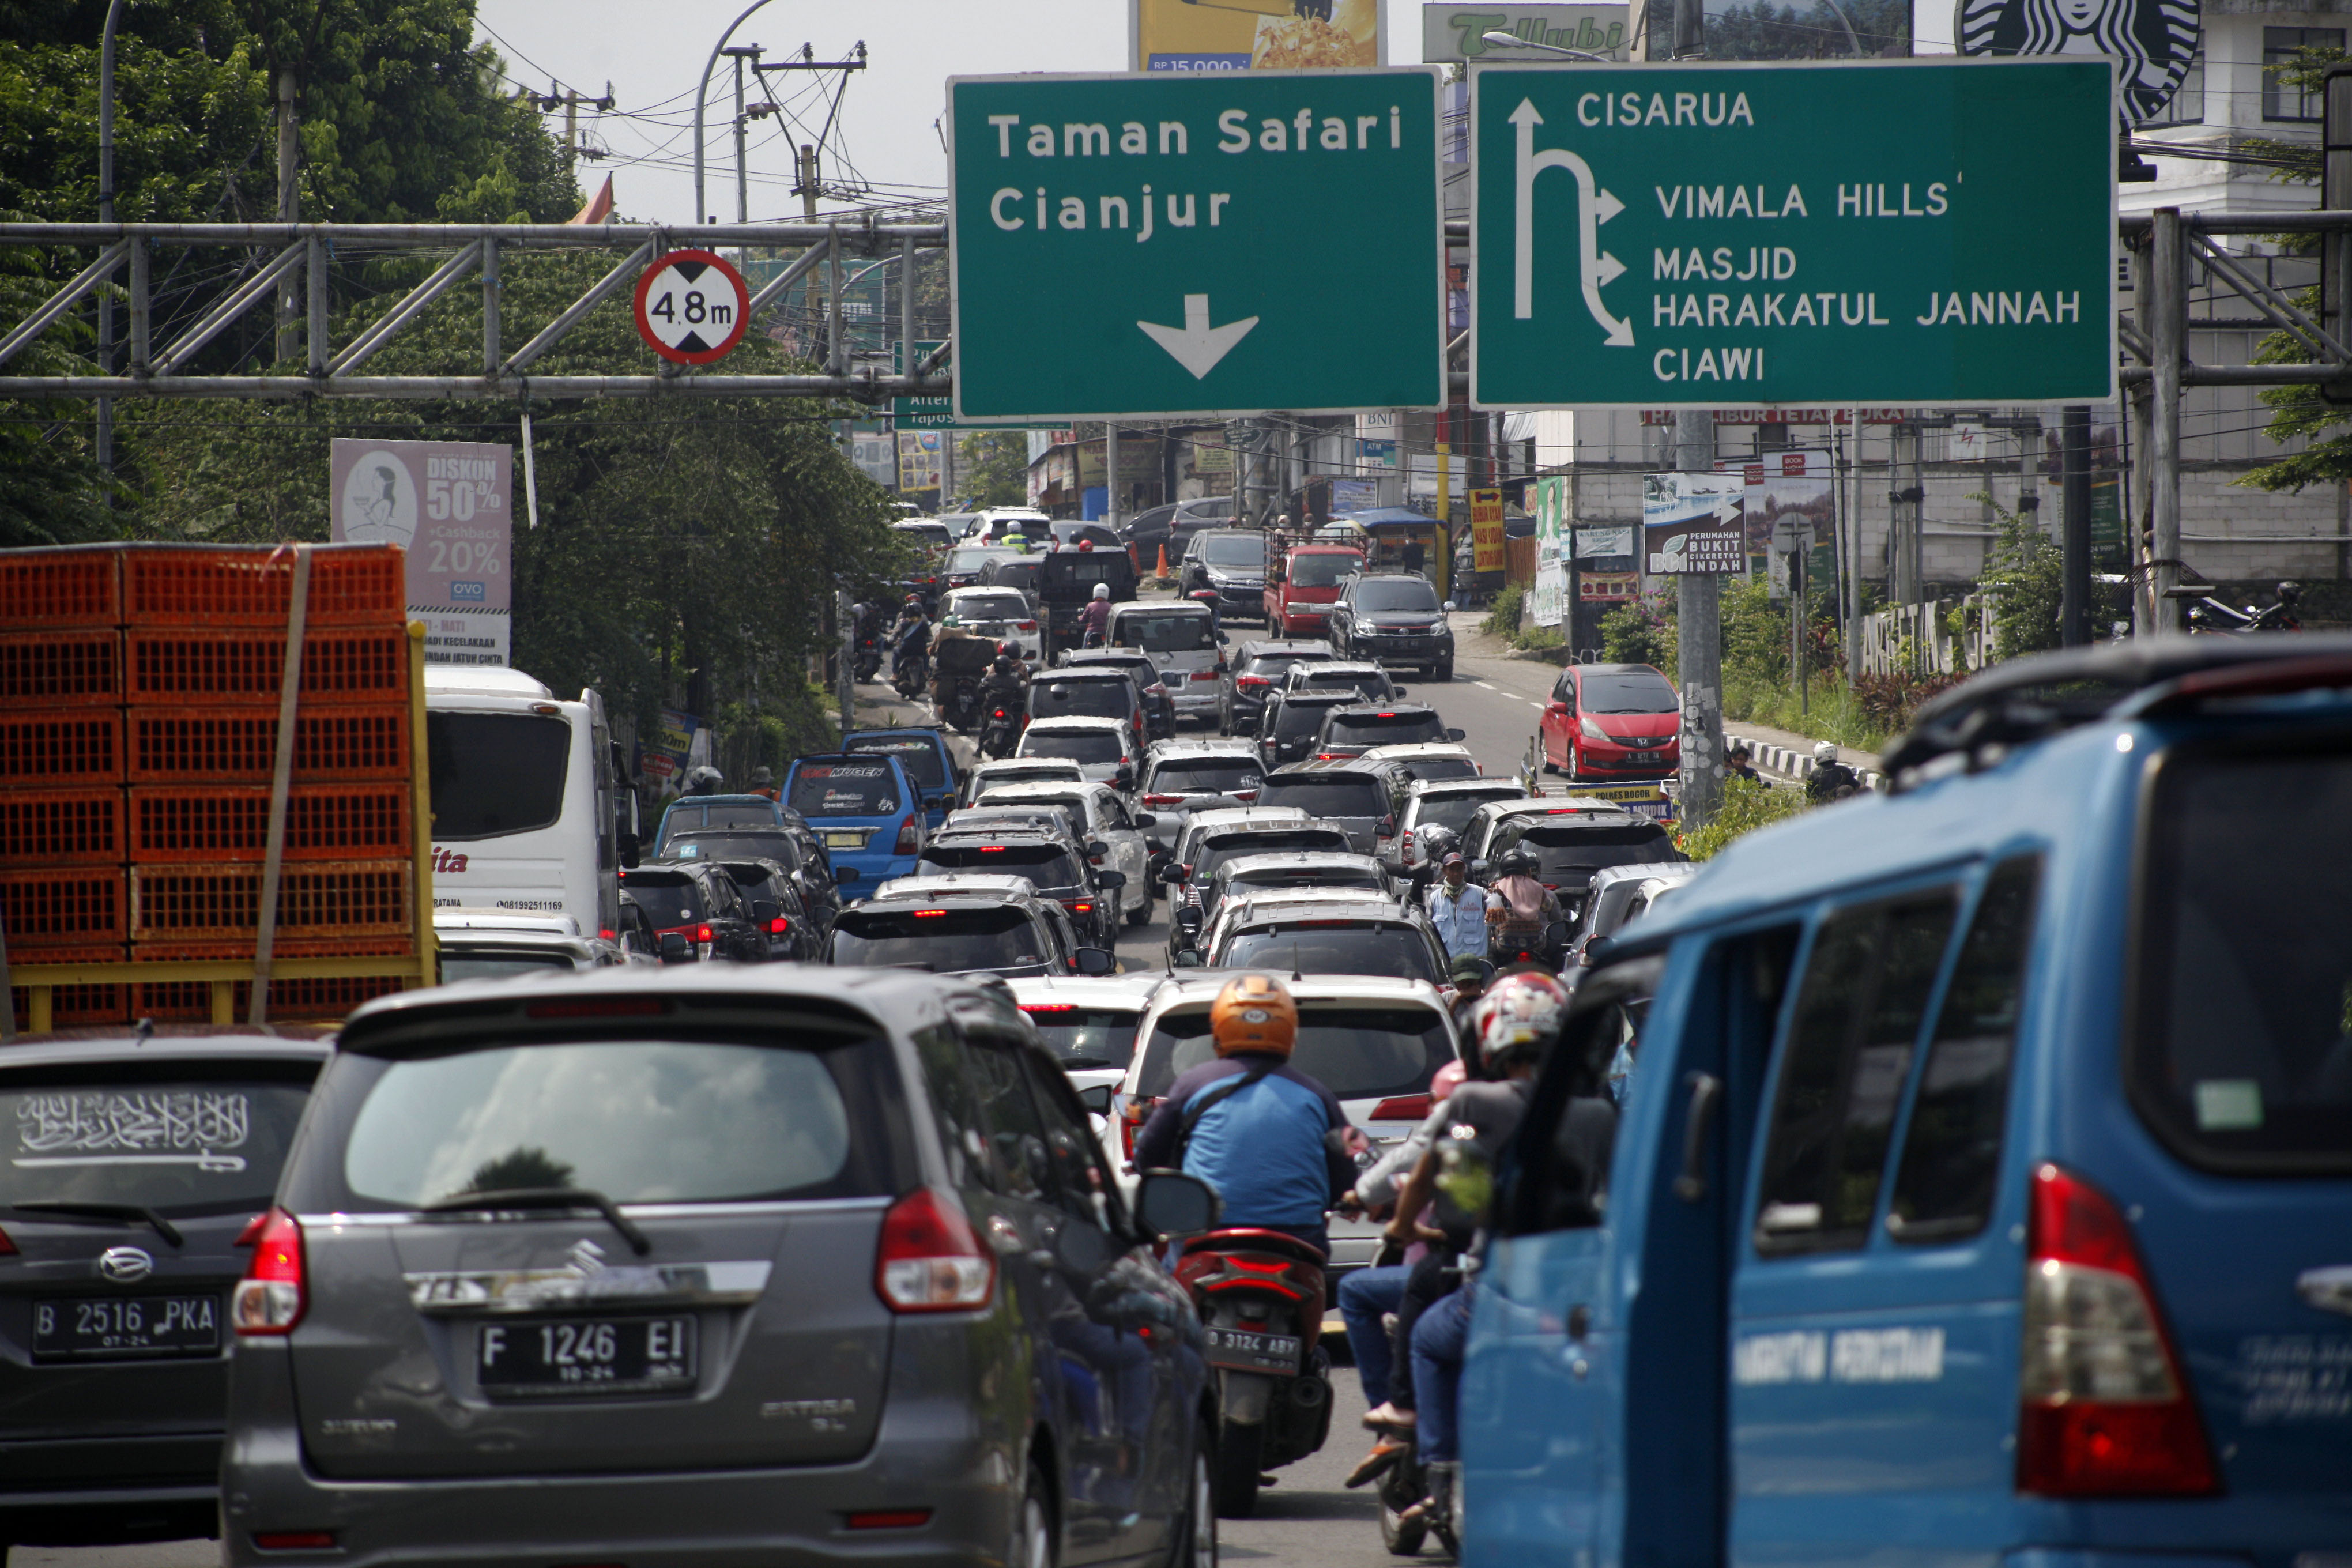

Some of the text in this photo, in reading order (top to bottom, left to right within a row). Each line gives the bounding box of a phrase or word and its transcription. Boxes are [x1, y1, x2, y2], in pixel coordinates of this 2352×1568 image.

[1577, 92, 1754, 126] CISARUA
[988, 105, 1401, 157] Taman Safari
[1655, 182, 1948, 218] VIMALA HILLS
[990, 184, 1231, 243] Cianjur
[1653, 247, 1797, 281] MASJID
[1654, 291, 2079, 327] HARAKATUL JANNAH
[1653, 348, 1763, 381] CIAWI
[1774, 409, 1838, 421] TETAP
[427, 458, 496, 480] DISKON
[427, 480, 501, 521] 50%
[429, 526, 500, 540] +Cashback
[1690, 532, 1740, 540] PERUMAHAN
[1690, 540, 1740, 552] BUKIT
[428, 541, 500, 574] 20%
[1690, 560, 1740, 572] INDAH
[453, 584, 482, 595] OVO
[443, 637, 496, 648] KECELAKAAN
[453, 653, 477, 664] JATUH
[478, 654, 503, 664] CINTA
[830, 768, 885, 777] MUGEN
[1596, 790, 1650, 800] POLRES BOGOR
[37, 1300, 213, 1335] B 2516 PKA
[483, 1321, 683, 1366] F 1246 EI
[1225, 1333, 1260, 1350] 3124
